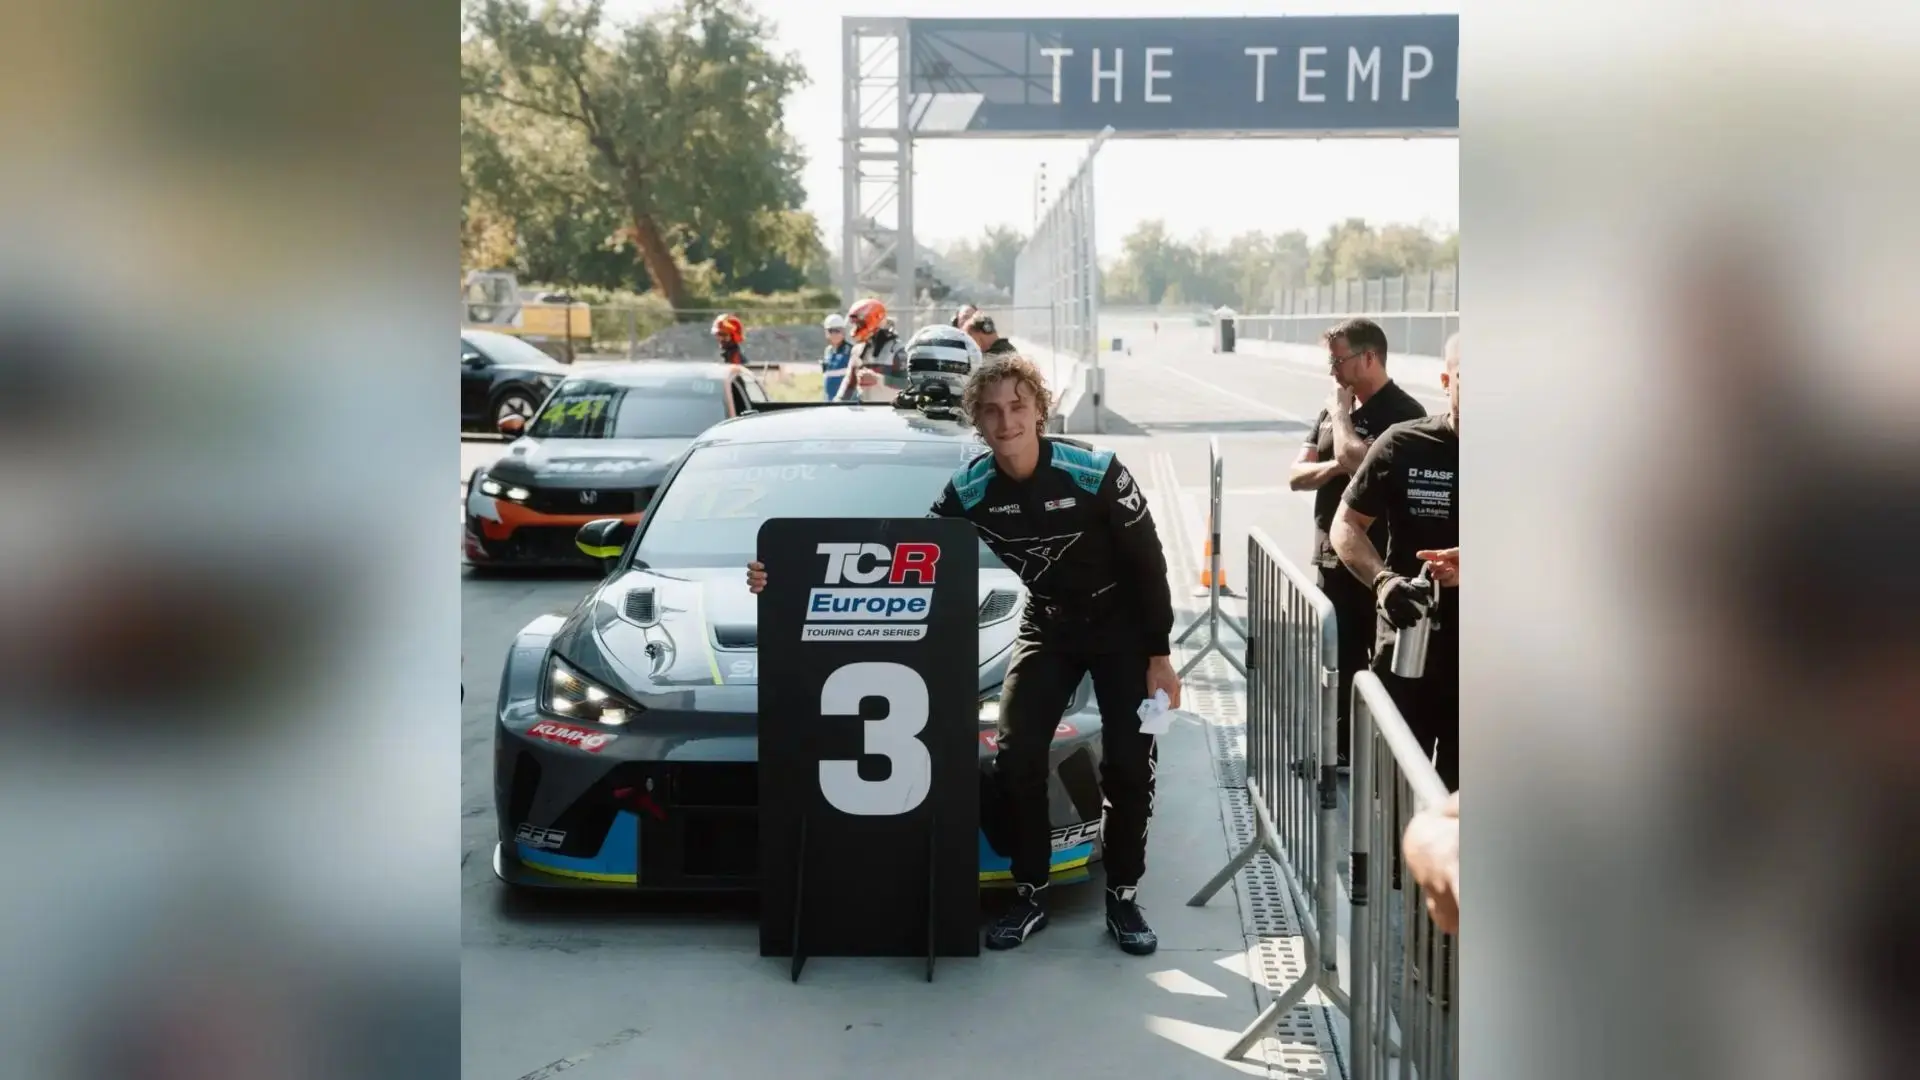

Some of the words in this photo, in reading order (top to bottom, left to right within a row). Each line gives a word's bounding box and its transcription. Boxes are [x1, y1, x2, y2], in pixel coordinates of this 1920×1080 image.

[1040, 47, 1173, 103] THE
[1244, 45, 1459, 102] TEMP
[1424, 469, 1453, 480] BASF
[816, 543, 941, 584] TCR
[811, 593, 927, 617] Europe
[807, 628, 854, 637] TOURING
[857, 628, 880, 637] CAR
[882, 628, 921, 637] SERIES
[532, 723, 605, 747] KUMHO
[819, 661, 931, 816] 3
